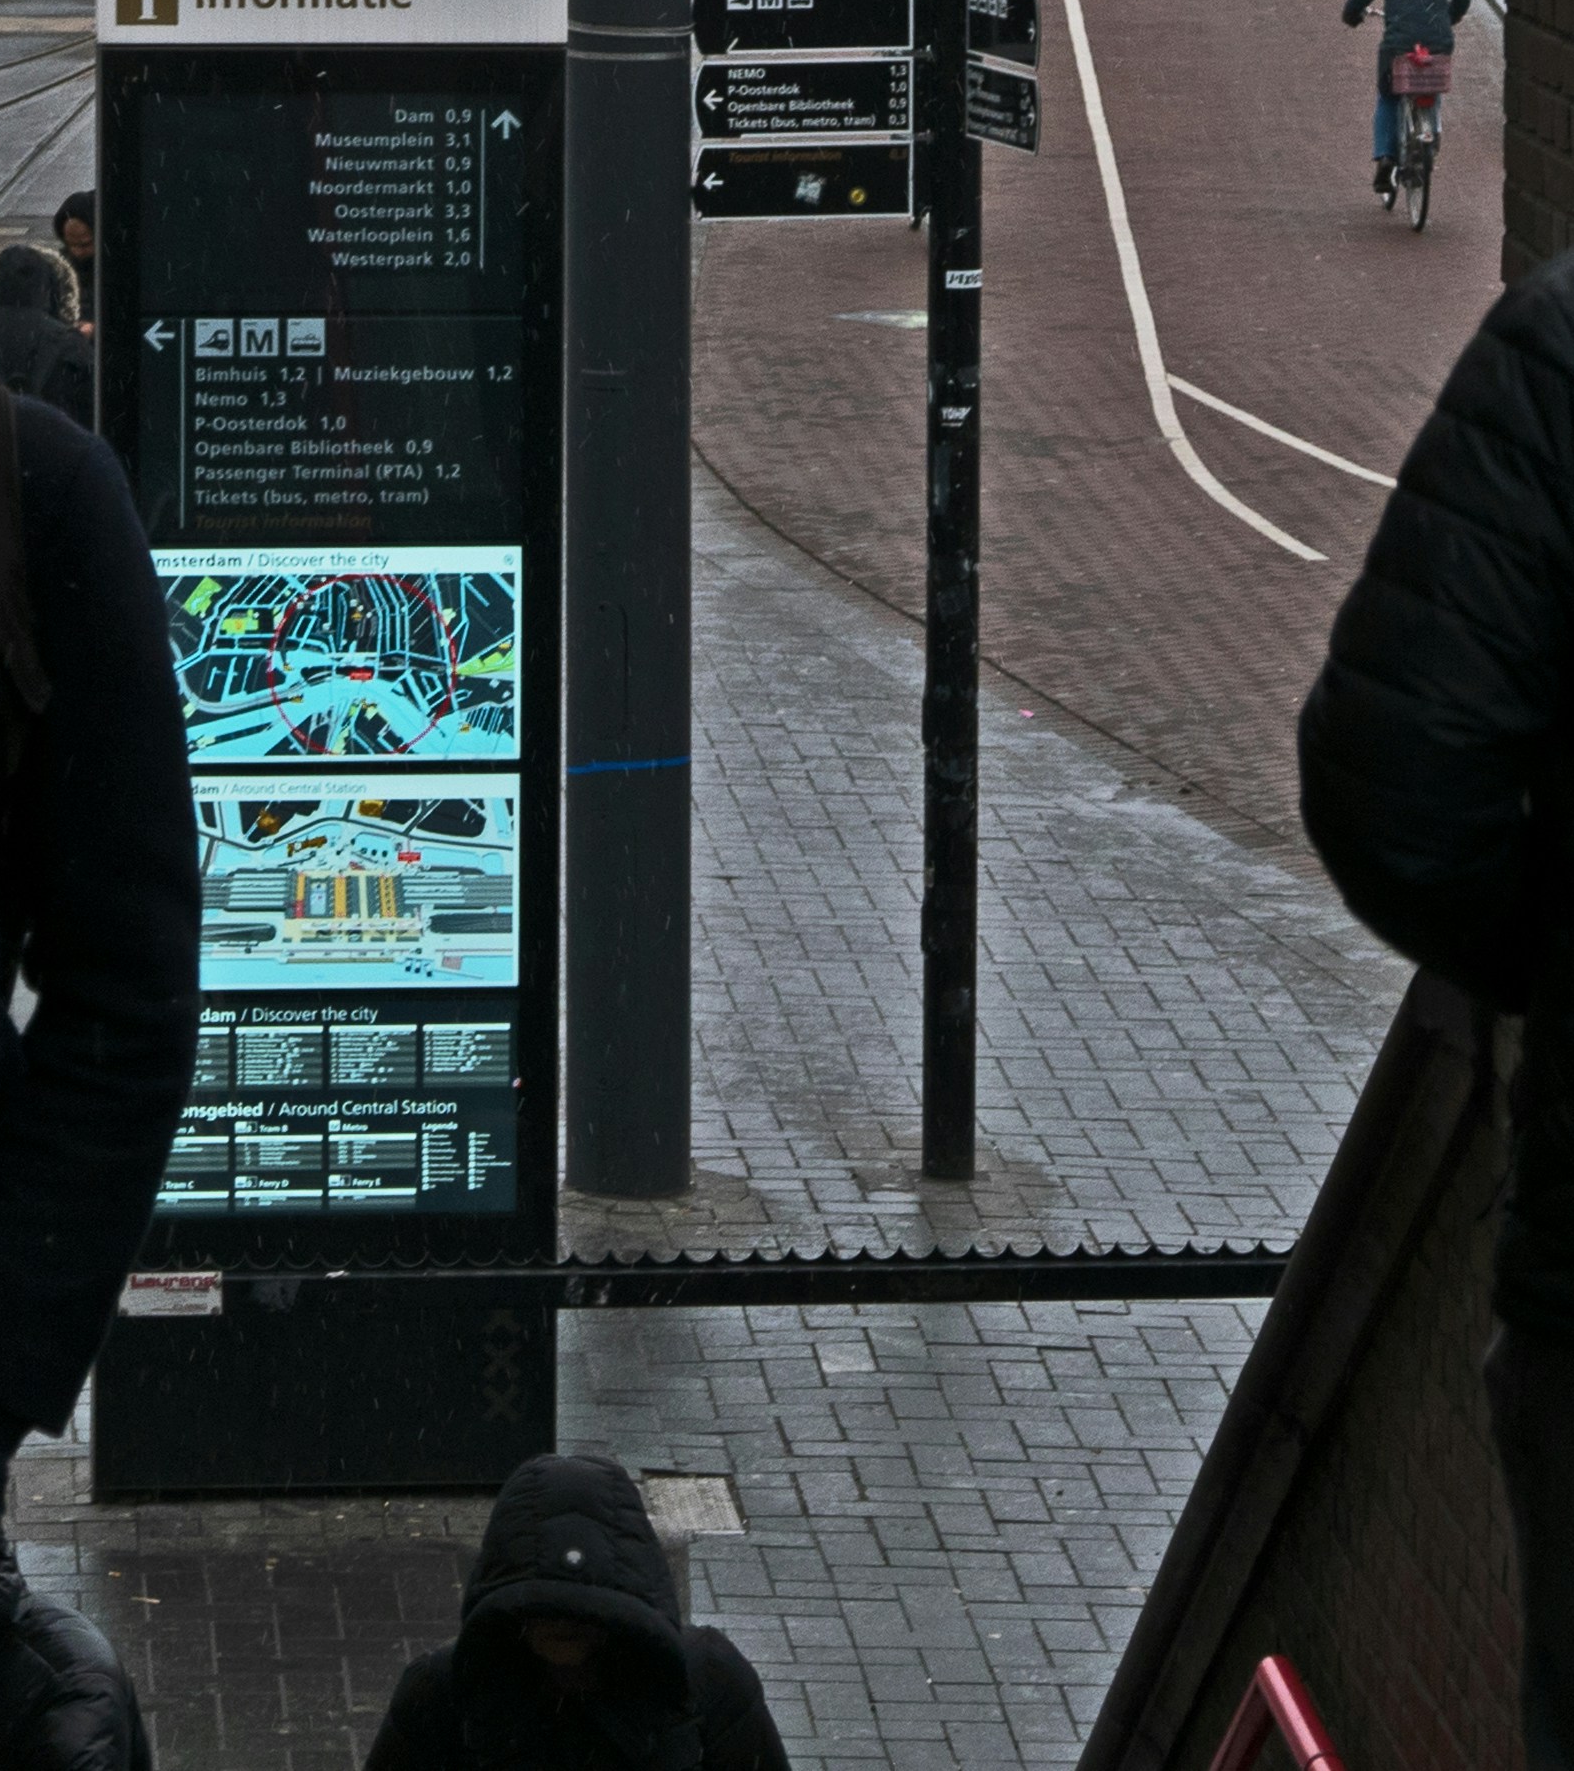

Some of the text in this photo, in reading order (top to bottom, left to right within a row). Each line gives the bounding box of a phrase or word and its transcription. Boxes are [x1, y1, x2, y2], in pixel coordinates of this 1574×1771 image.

[728, 65, 907, 79] NEMO 1,3
[728, 81, 907, 96] P-Oosterdok 1,0
[727, 97, 907, 114] Openbare Bibliotheek 0,9
[395, 109, 472, 124] Dam 0,9
[728, 114, 907, 128] Tickets (bus, metro, tram) 0,3
[315, 132, 470, 149] Museumplein 3,1
[326, 156, 471, 171] Nieuwmarkt 0,9
[310, 180, 471, 195] Noordermarkt 1,0
[335, 204, 470, 221] Oosterpark 3,3
[308, 228, 470, 245] Waterlooplein 1,6
[332, 251, 471, 268] Westerpark 2,0
[195, 365, 512, 384] Bimhuis 1,2 Muziekgebouw 1,2
[195, 391, 286, 407] Nemo 1,3
[195, 416, 346, 431] P-Oosterdok 1,0
[195, 439, 433, 458] Openbare Bibliotheek 0,9
[195, 464, 460, 483] Passenger Terminal (PTA) 1,2
[195, 488, 429, 505] Tickets (bus, metro, tram)
[155, 553, 242, 568] msterdam
[258, 553, 324, 567] Discover
[330, 553, 356, 566] the
[361, 553, 390, 570] city
[231, 782, 275, 795] Around
[279, 782, 325, 795] Central
[327, 781, 366, 794] Station
[252, 1007, 317, 1022] Discover
[322, 1006, 346, 1021] the
[350, 1007, 379, 1024] city
[279, 1101, 334, 1117] Around
[342, 1099, 398, 1115] Central
[402, 1100, 457, 1114] Station
